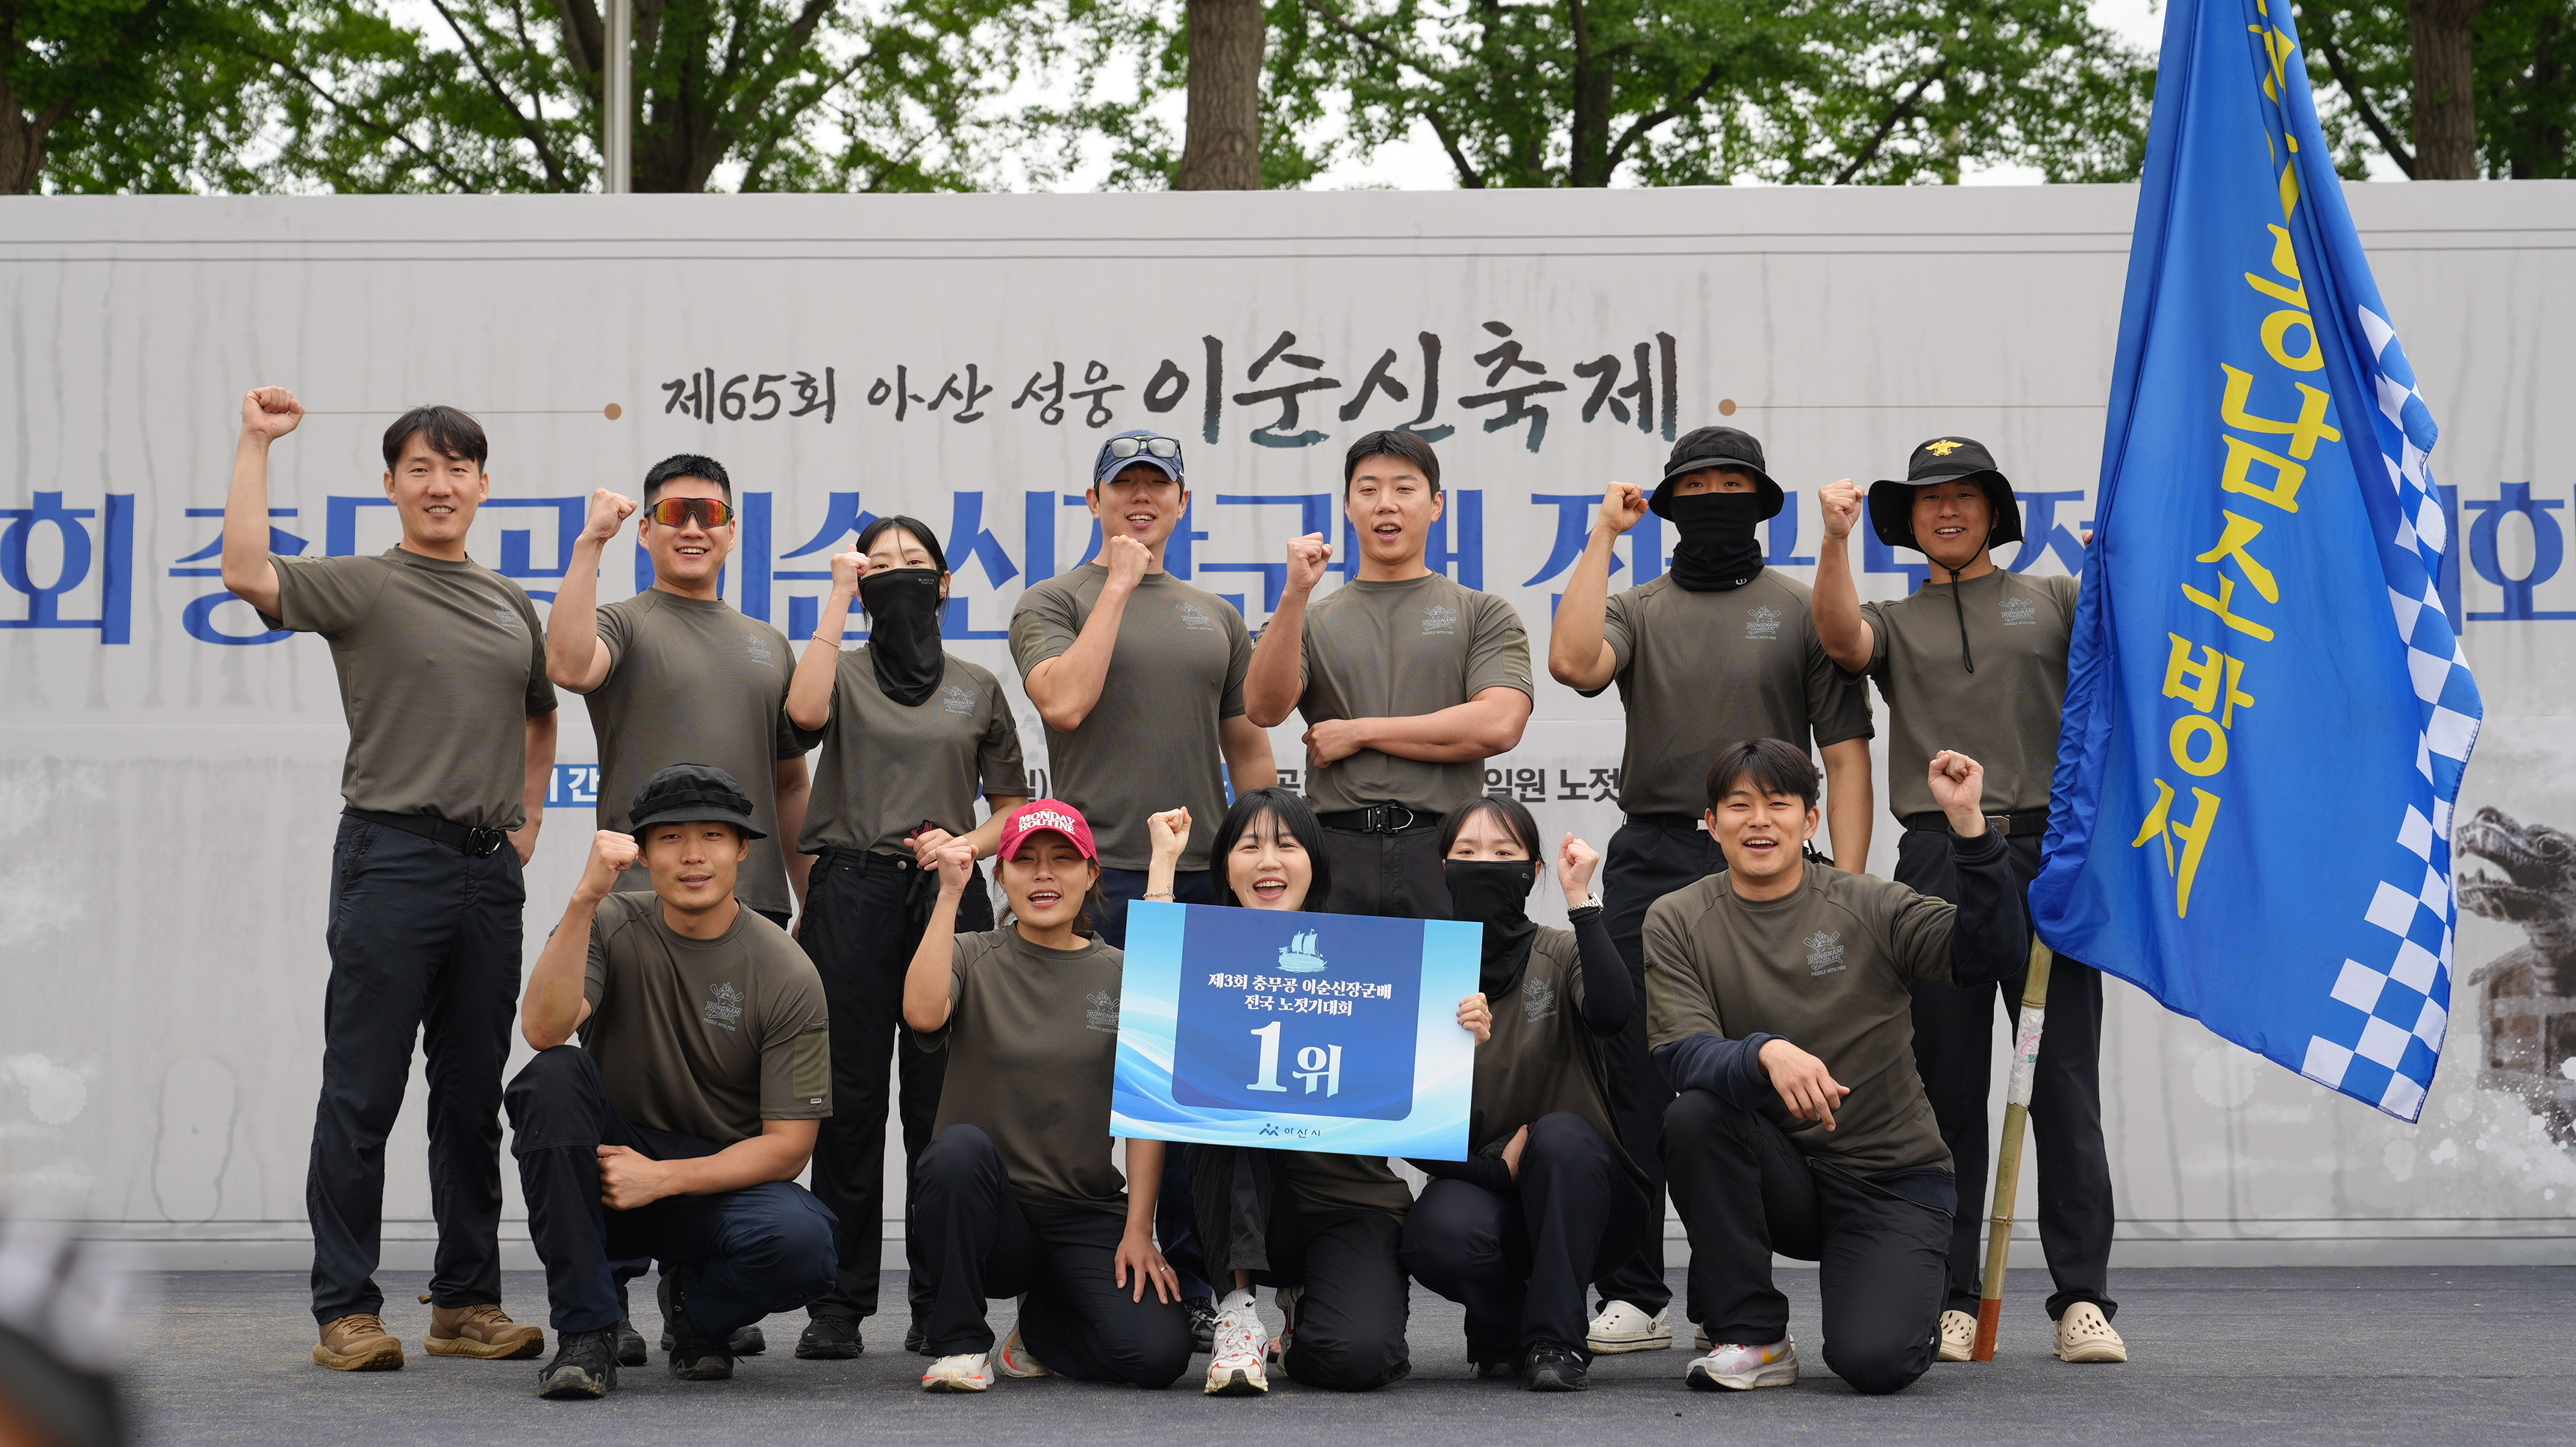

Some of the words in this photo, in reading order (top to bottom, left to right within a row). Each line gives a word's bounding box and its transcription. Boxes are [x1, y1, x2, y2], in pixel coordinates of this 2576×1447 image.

[662, 367, 835, 424] 제65회
[867, 364, 992, 422] 아산
[1012, 360, 1125, 428] 성웅
[1144, 321, 1678, 453] 이순신축제
[2003, 610, 2035, 618] DONGNAM
[1484, 768, 1545, 802] 일원
[1018, 810, 1076, 826] MONDAY
[1018, 819, 1075, 835] ROUTINE
[1808, 946, 1843, 964] DONGNAM
[1815, 954, 1839, 965] PADDLES
[1208, 972, 1248, 990] 제3회
[1252, 974, 1298, 993] 충무공
[1302, 979, 1392, 1000] 이순신장군배
[706, 1003, 741, 1015] DONGNAM
[1245, 994, 1276, 1012] 전국
[1278, 996, 1353, 1017] 노젓기대회
[1525, 993, 1554, 1010] DONGNAM
[712, 1009, 736, 1018] PADDLES
[1088, 1010, 1120, 1019] DONGNAM
[704, 1018, 718, 1026] PADDLE
[1246, 1021, 1343, 1098] 1위
[1284, 1128, 1320, 1138] 아산시
